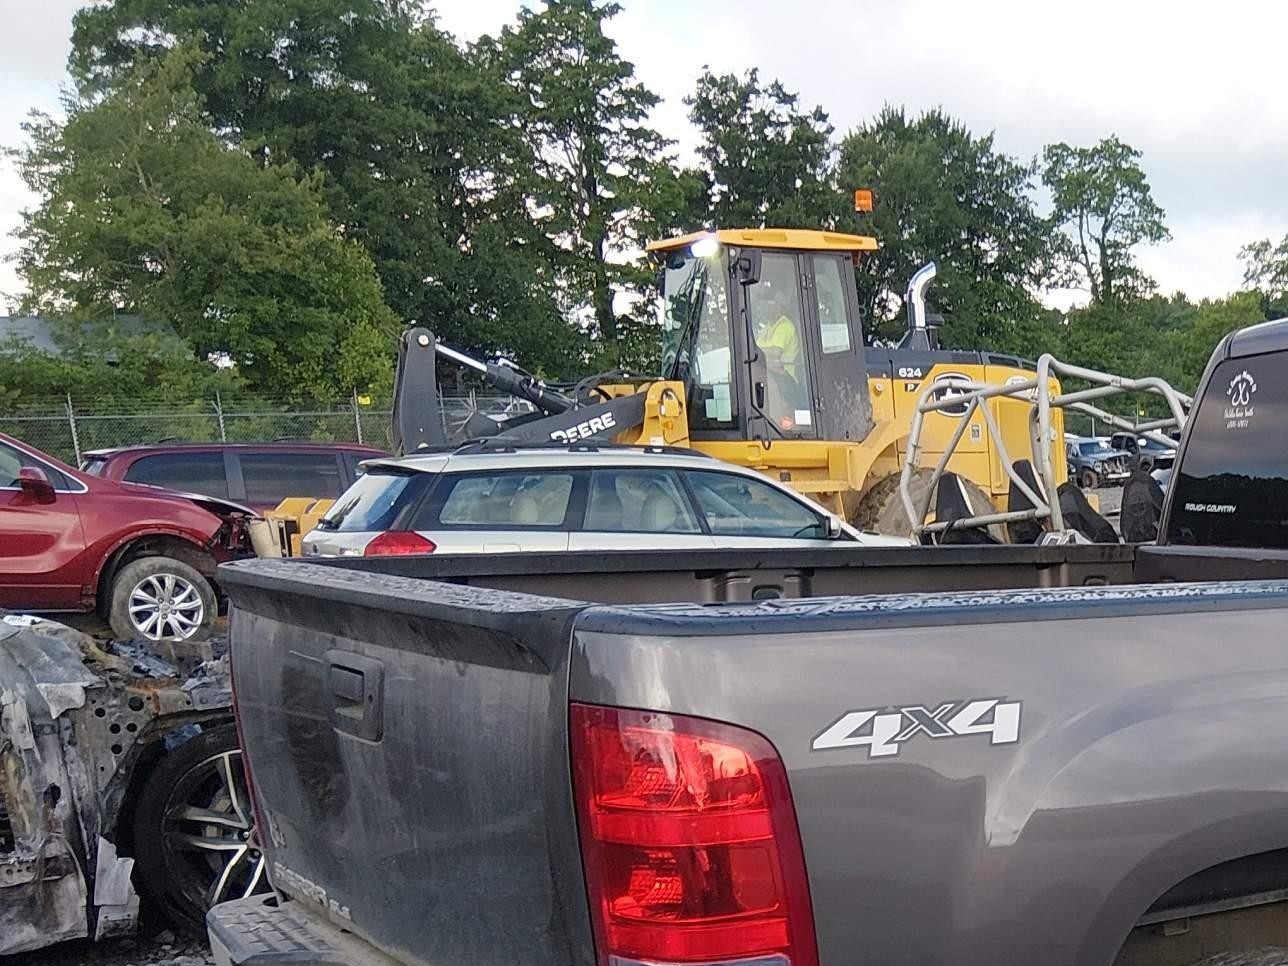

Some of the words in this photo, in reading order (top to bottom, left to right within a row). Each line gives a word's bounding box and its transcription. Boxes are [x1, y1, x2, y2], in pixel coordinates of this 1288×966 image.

[898, 367, 922, 378] 624
[550, 411, 617, 444] DEERE
[1184, 502, 1206, 512] ROUGH
[1206, 503, 1237, 513] COUNTRY
